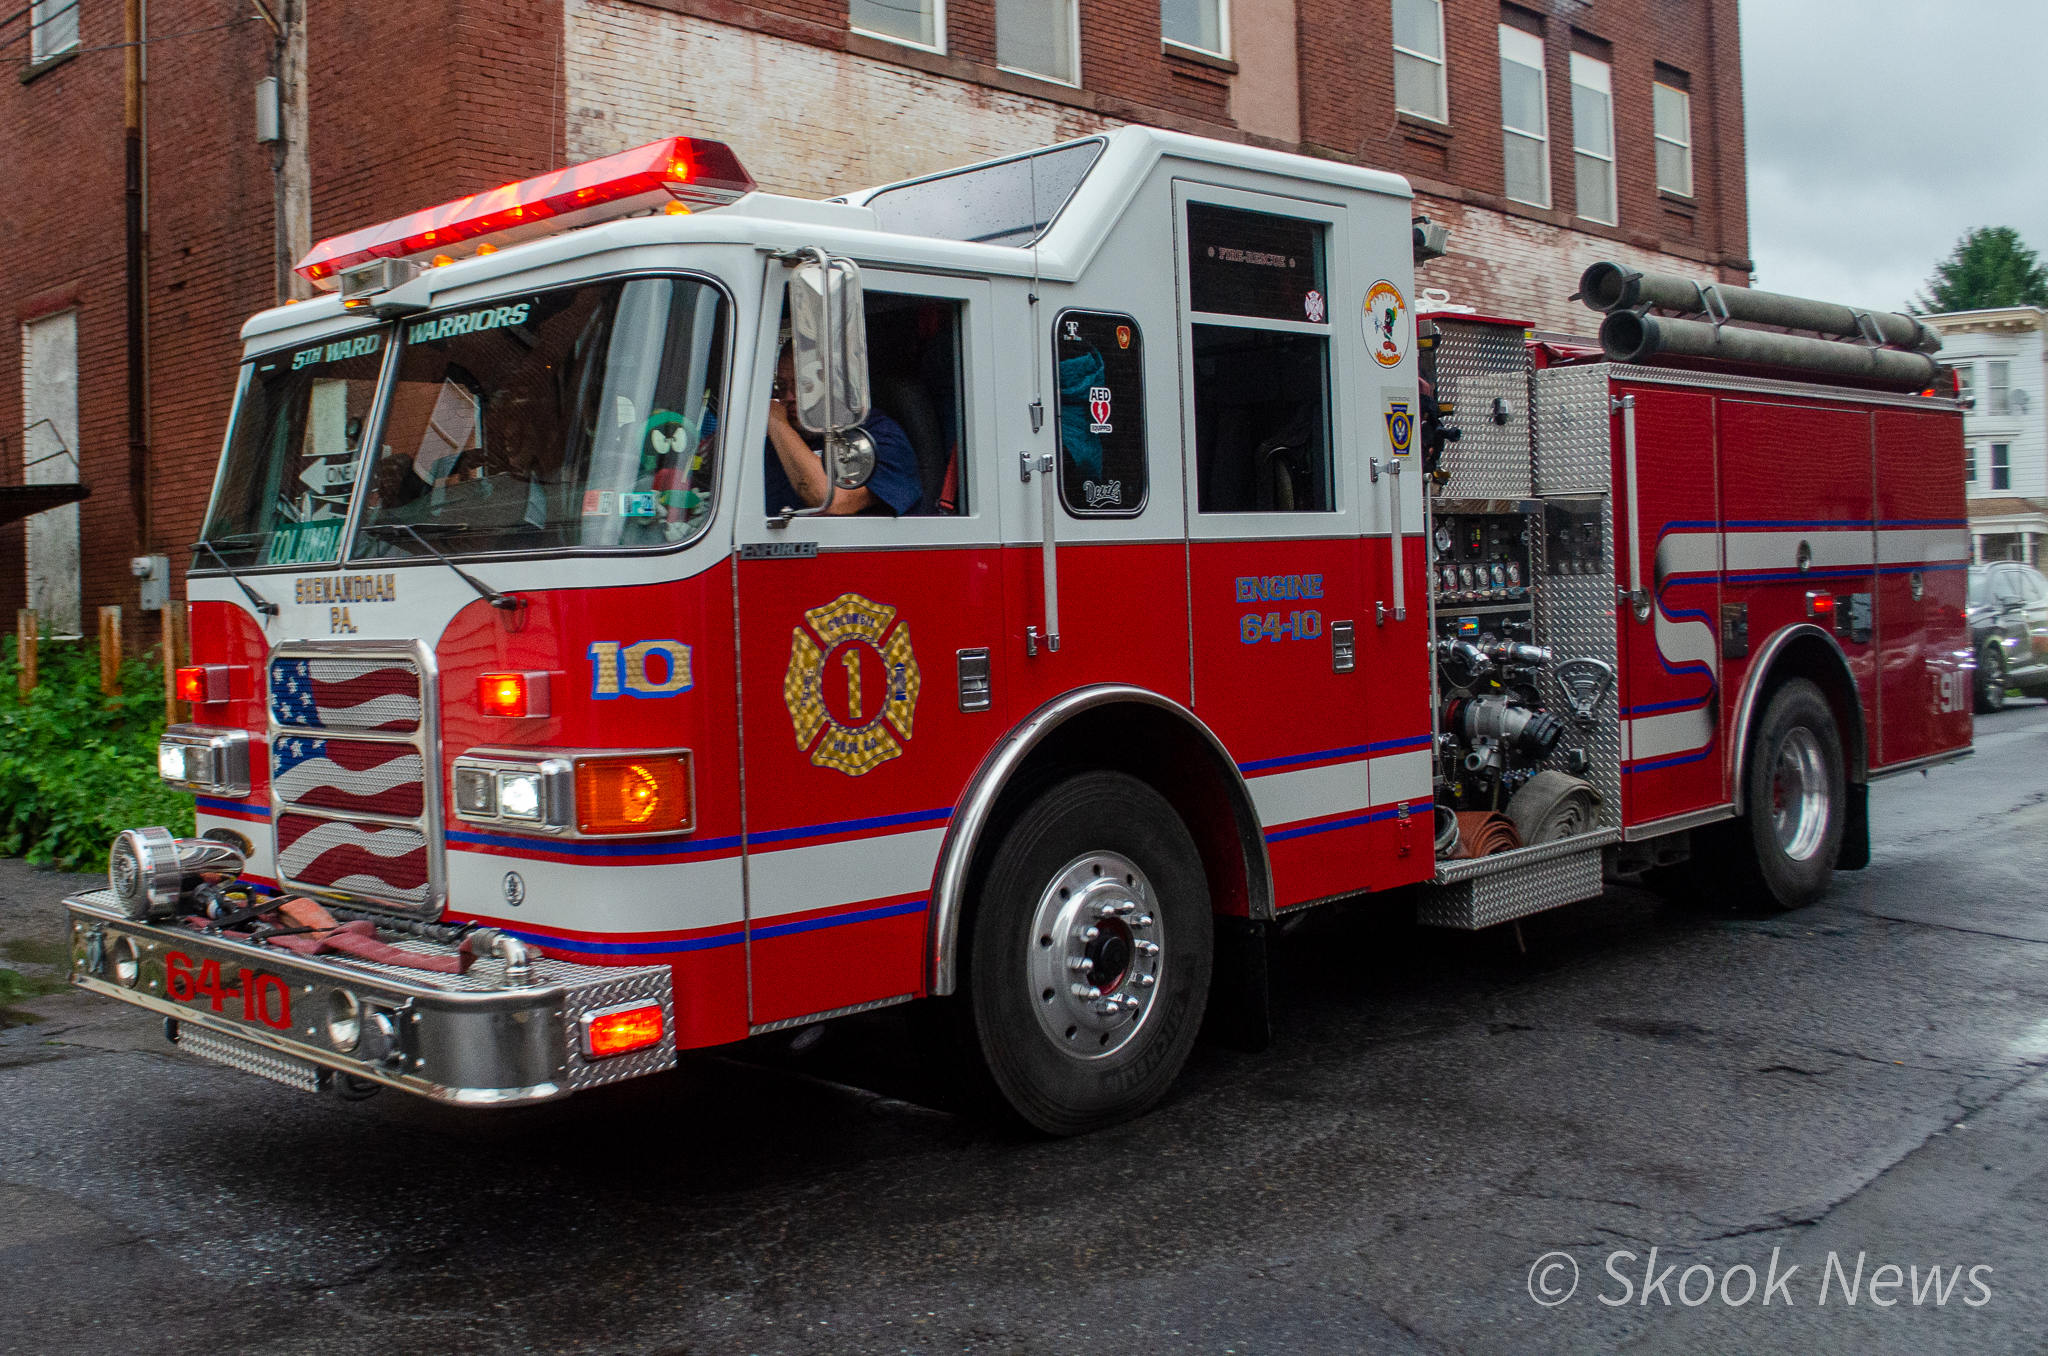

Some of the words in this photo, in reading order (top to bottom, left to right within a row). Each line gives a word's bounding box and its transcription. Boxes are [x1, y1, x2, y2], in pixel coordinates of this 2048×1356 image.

[1218, 246, 1286, 268] FIRE-RESCUE
[291, 345, 324, 371] 5TH
[325, 334, 382, 362] WARD
[408, 303, 531, 345] WARRIORS
[1090, 388, 1110, 402] AED
[327, 465, 351, 483] ONE
[741, 542, 818, 560] ENFORCER
[296, 573, 396, 605] SHENANDOAH
[1236, 574, 1324, 603] ENGINE
[1240, 610, 1322, 644] 64-10
[586, 639, 695, 700] 10
[841, 648, 862, 719] 1
[1941, 670, 1964, 713] 911
[165, 950, 293, 1030] 64-10
